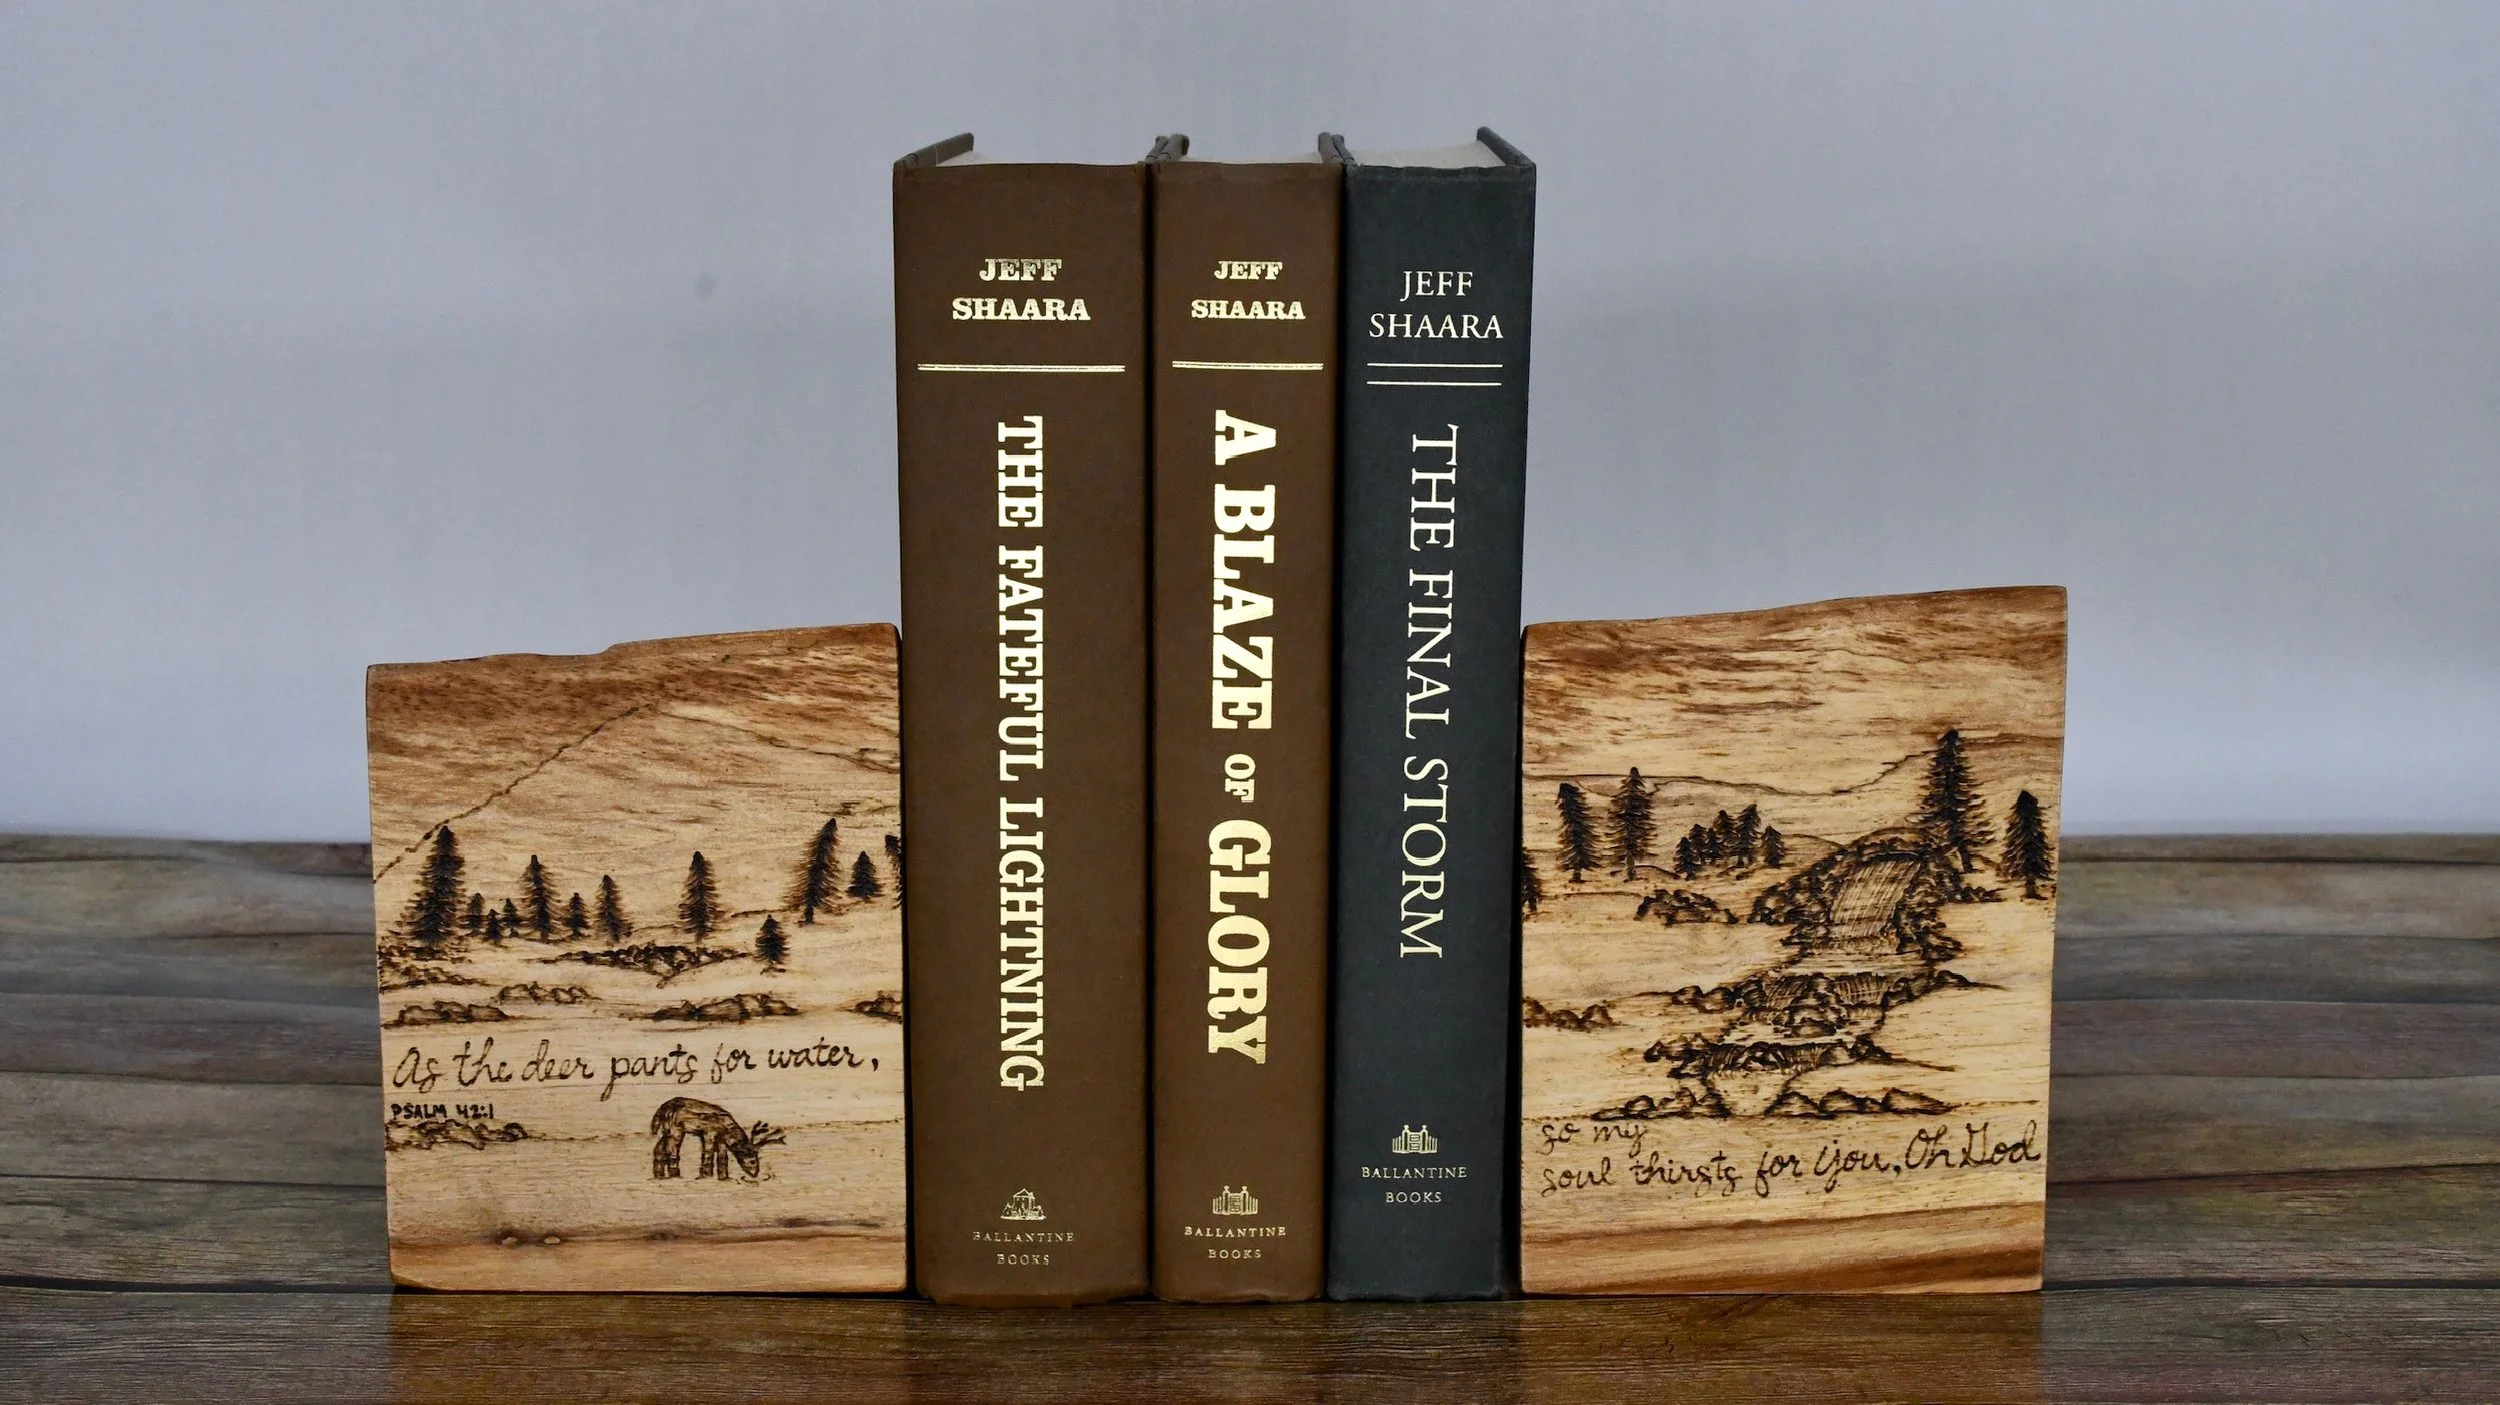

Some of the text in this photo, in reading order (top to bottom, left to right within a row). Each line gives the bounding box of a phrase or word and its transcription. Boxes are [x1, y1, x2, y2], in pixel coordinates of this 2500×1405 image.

[978, 258, 1063, 282] JEFF
[1213, 260, 1284, 281] JEFF
[1399, 270, 1474, 303] JEFF
[951, 296, 1092, 322] SHAARA
[1190, 298, 1307, 321] SHAARA
[1368, 312, 1504, 340] SHAARA
[1399, 421, 1460, 959] THE FINAL STORM
[1206, 409, 1277, 1065] A BLAZE OF GLORY
[997, 415, 1045, 1092] THE FATEFUL LIGHTNING
[392, 1047, 447, 1094] As
[453, 1036, 513, 1086] the
[521, 1039, 595, 1082] deer
[600, 1043, 699, 1101] pants
[710, 1042, 757, 1084] for
[390, 1102, 494, 1120] PSALM 42:1
[1541, 1122, 1649, 1159] so my
[1541, 1156, 1615, 1197] soul
[1629, 1150, 1743, 1197] thirsts
[1755, 1150, 1803, 1198] for
[1905, 1124, 1955, 1169] Oh
[1958, 1119, 2041, 1168] God
[1361, 1166, 1467, 1179] BALLANTINE
[1385, 1191, 1442, 1204] BOOKS
[972, 1231, 1075, 1243] BALLANTINE
[1183, 1225, 1287, 1239] BALLANTINE
[996, 1253, 1050, 1266] BOOKS
[1207, 1248, 1262, 1260] BOOKS
